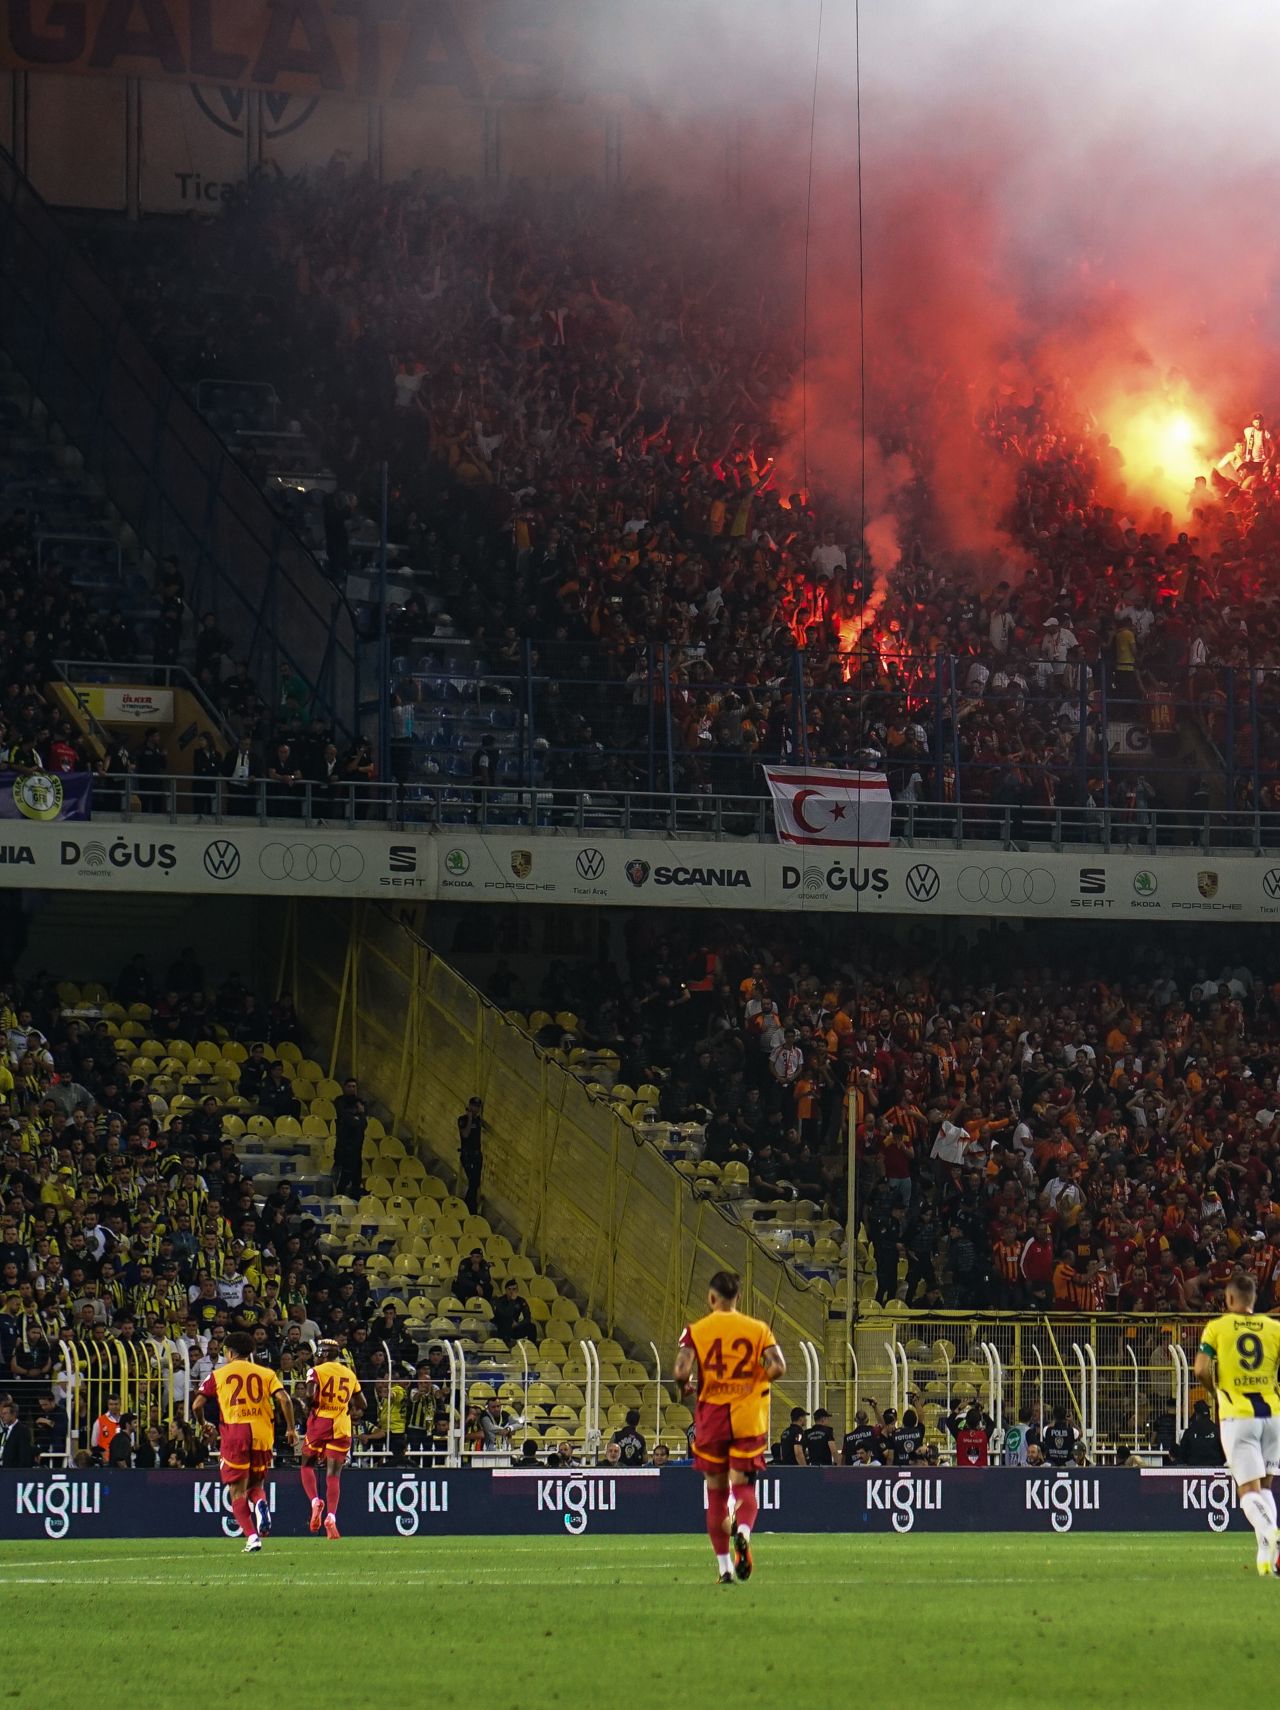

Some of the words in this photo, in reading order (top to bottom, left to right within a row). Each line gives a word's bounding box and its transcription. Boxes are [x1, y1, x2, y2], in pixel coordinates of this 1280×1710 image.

[174, 172, 240, 202] Tica
[379, 877, 427, 887] SEAT
[653, 866, 752, 887] SCANIA
[484, 880, 556, 891] PORSCHE
[573, 887, 593, 896] Ticari
[1070, 899, 1116, 908] SEAT
[1171, 902, 1243, 911] PORSCHE
[1259, 906, 1278, 914] Ticari
[703, 1337, 753, 1380] 42
[1236, 1332, 1264, 1371] 9
[225, 1373, 264, 1406] 20
[321, 1375, 350, 1403] 45
